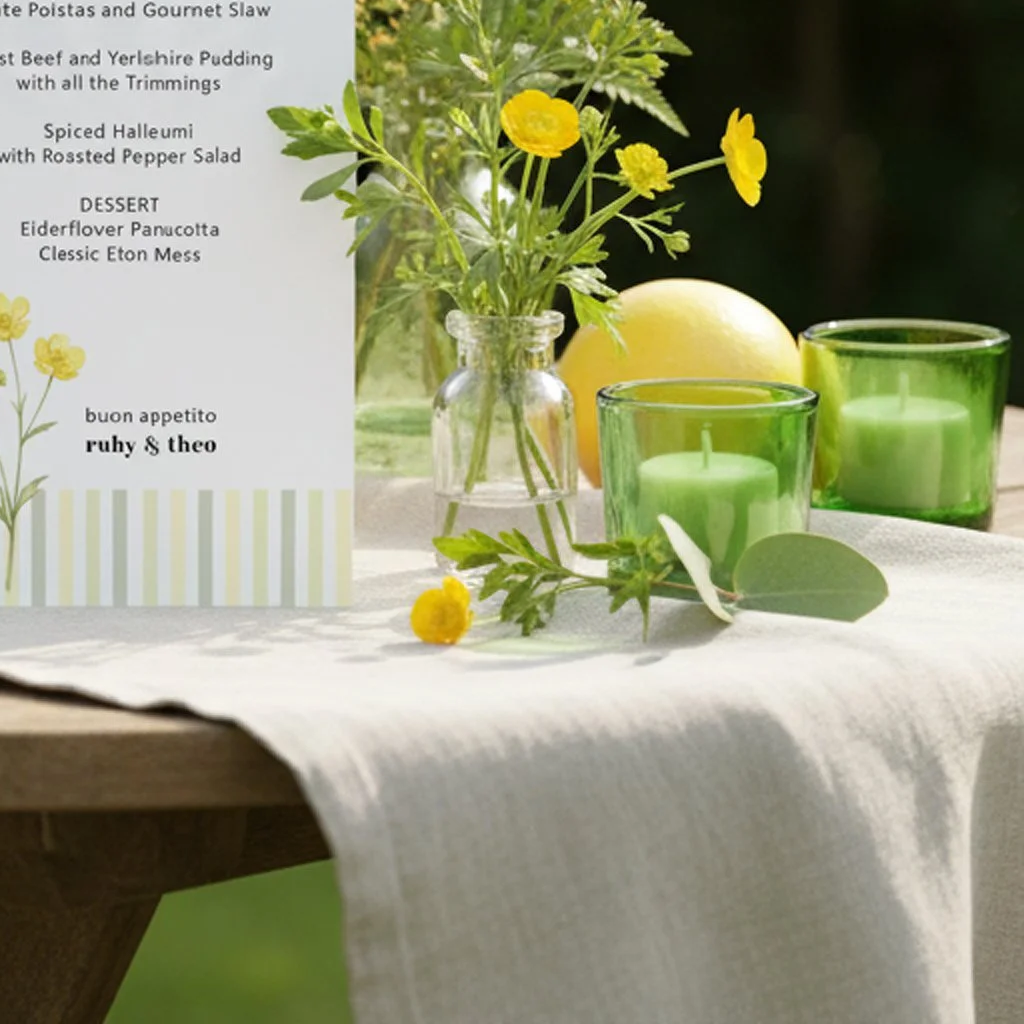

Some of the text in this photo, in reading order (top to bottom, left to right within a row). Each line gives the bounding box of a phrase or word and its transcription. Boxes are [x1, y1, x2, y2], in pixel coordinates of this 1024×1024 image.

[101, 2, 135, 17] and
[229, 2, 272, 17] Slaw
[21, 50, 62, 66] Beef
[69, 50, 101, 66] and
[199, 50, 274, 71] Pudding
[16, 75, 221, 96] with all the Trimmings
[43, 123, 106, 143] Spiced
[122, 148, 186, 168] Pepper
[193, 146, 242, 164] Salad
[80, 197, 159, 213] DESSERT
[107, 246, 147, 262] Eton
[154, 247, 201, 263] Mess
[85, 408, 217, 427] buon appetito
[144, 435, 160, 456] &
[167, 434, 217, 453] theo
